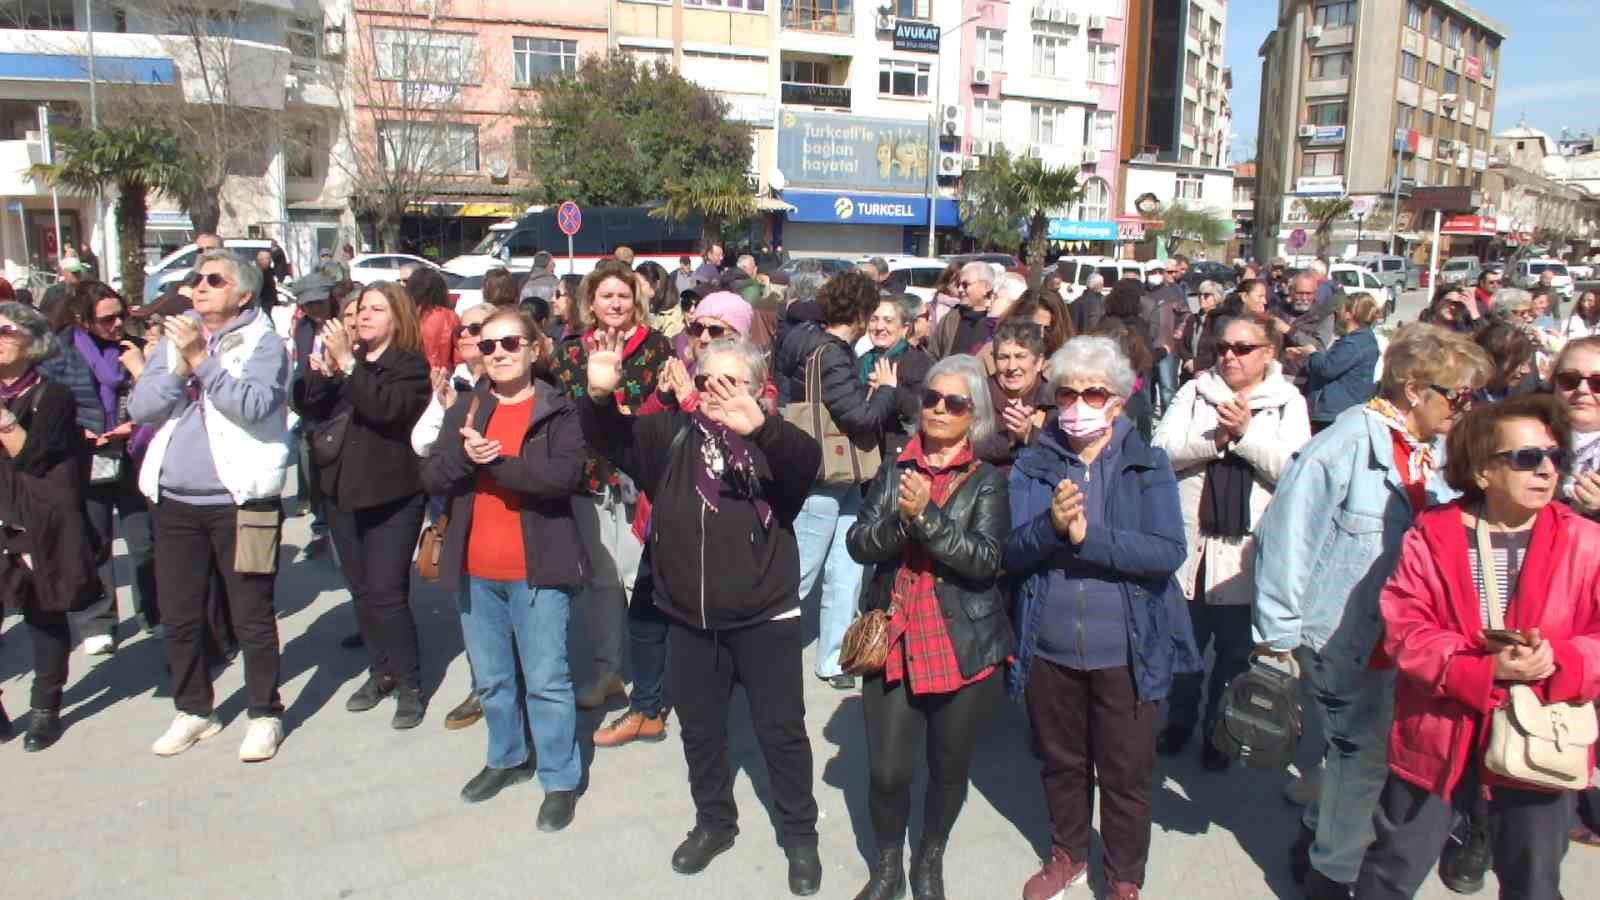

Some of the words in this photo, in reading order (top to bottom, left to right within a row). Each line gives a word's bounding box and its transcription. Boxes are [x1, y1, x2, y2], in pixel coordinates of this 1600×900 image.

[896, 24, 939, 40] AVUKAT
[802, 157, 858, 175] hayata!
[857, 202, 914, 217] TURKCELL
